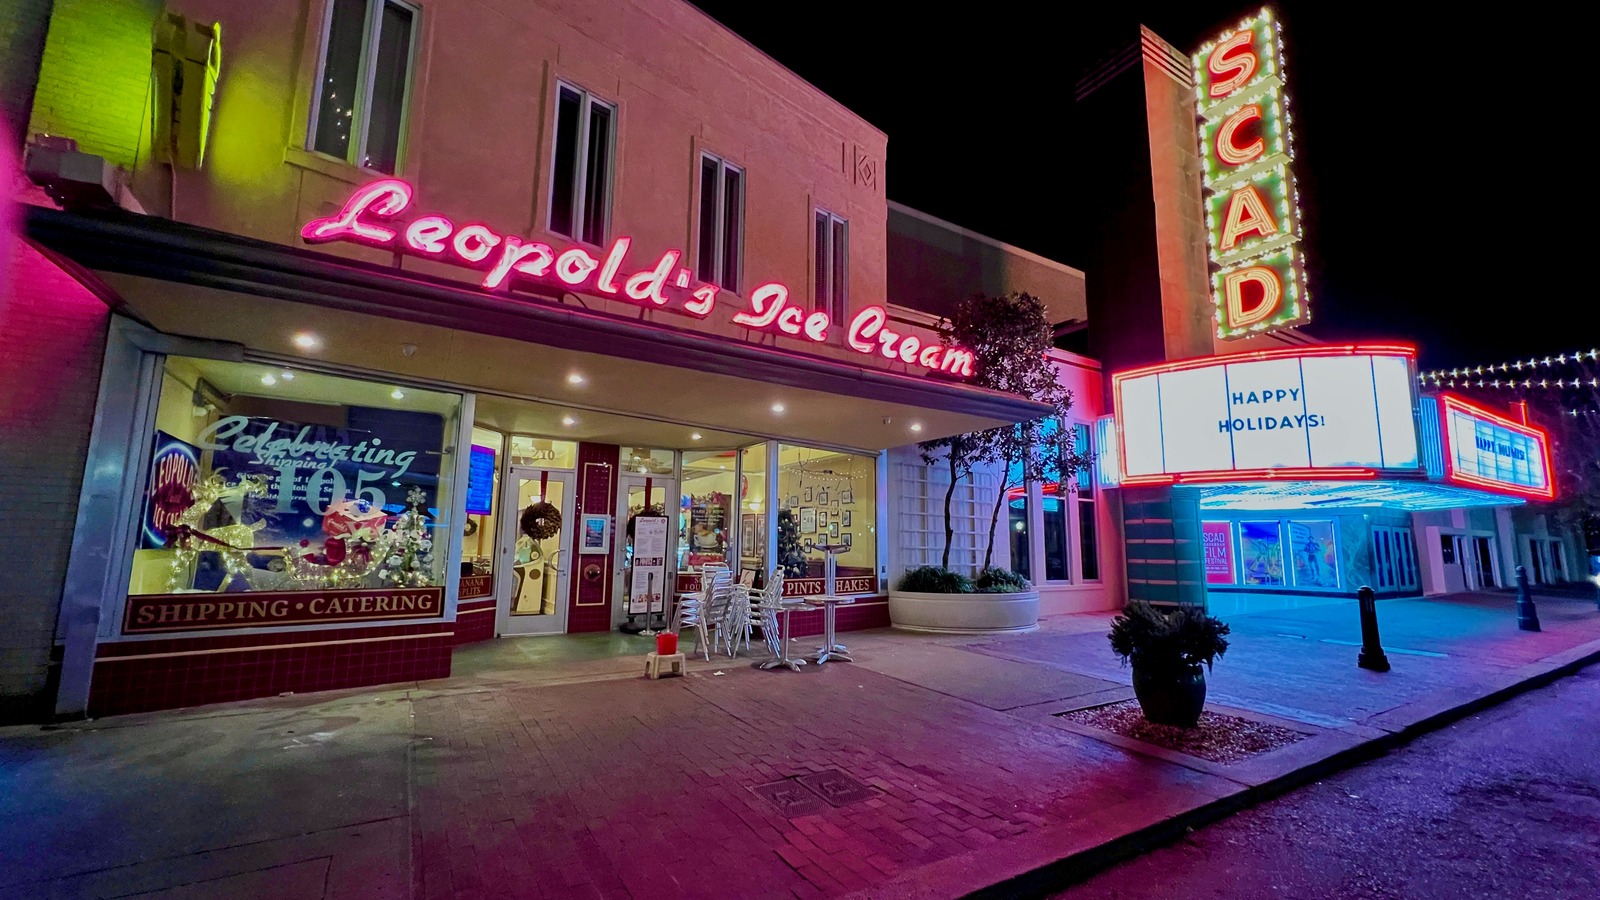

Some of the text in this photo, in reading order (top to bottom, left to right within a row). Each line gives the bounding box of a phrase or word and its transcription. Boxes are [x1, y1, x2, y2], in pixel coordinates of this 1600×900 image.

[1206, 29, 1281, 328] SCAD
[301, 179, 975, 377] Leopold's Ice Cream
[1232, 388, 1300, 405] HAPPY
[1218, 414, 1325, 433] HOLIDAYS!
[196, 415, 418, 479] Celebrating
[273, 465, 387, 516] 105
[1203, 532, 1225, 543] SCAD
[1204, 546, 1227, 558] FILM
[460, 578, 484, 588] ANANA
[786, 579, 870, 595] PINTS HAKES
[137, 594, 432, 623] SHIPPING CATERING
